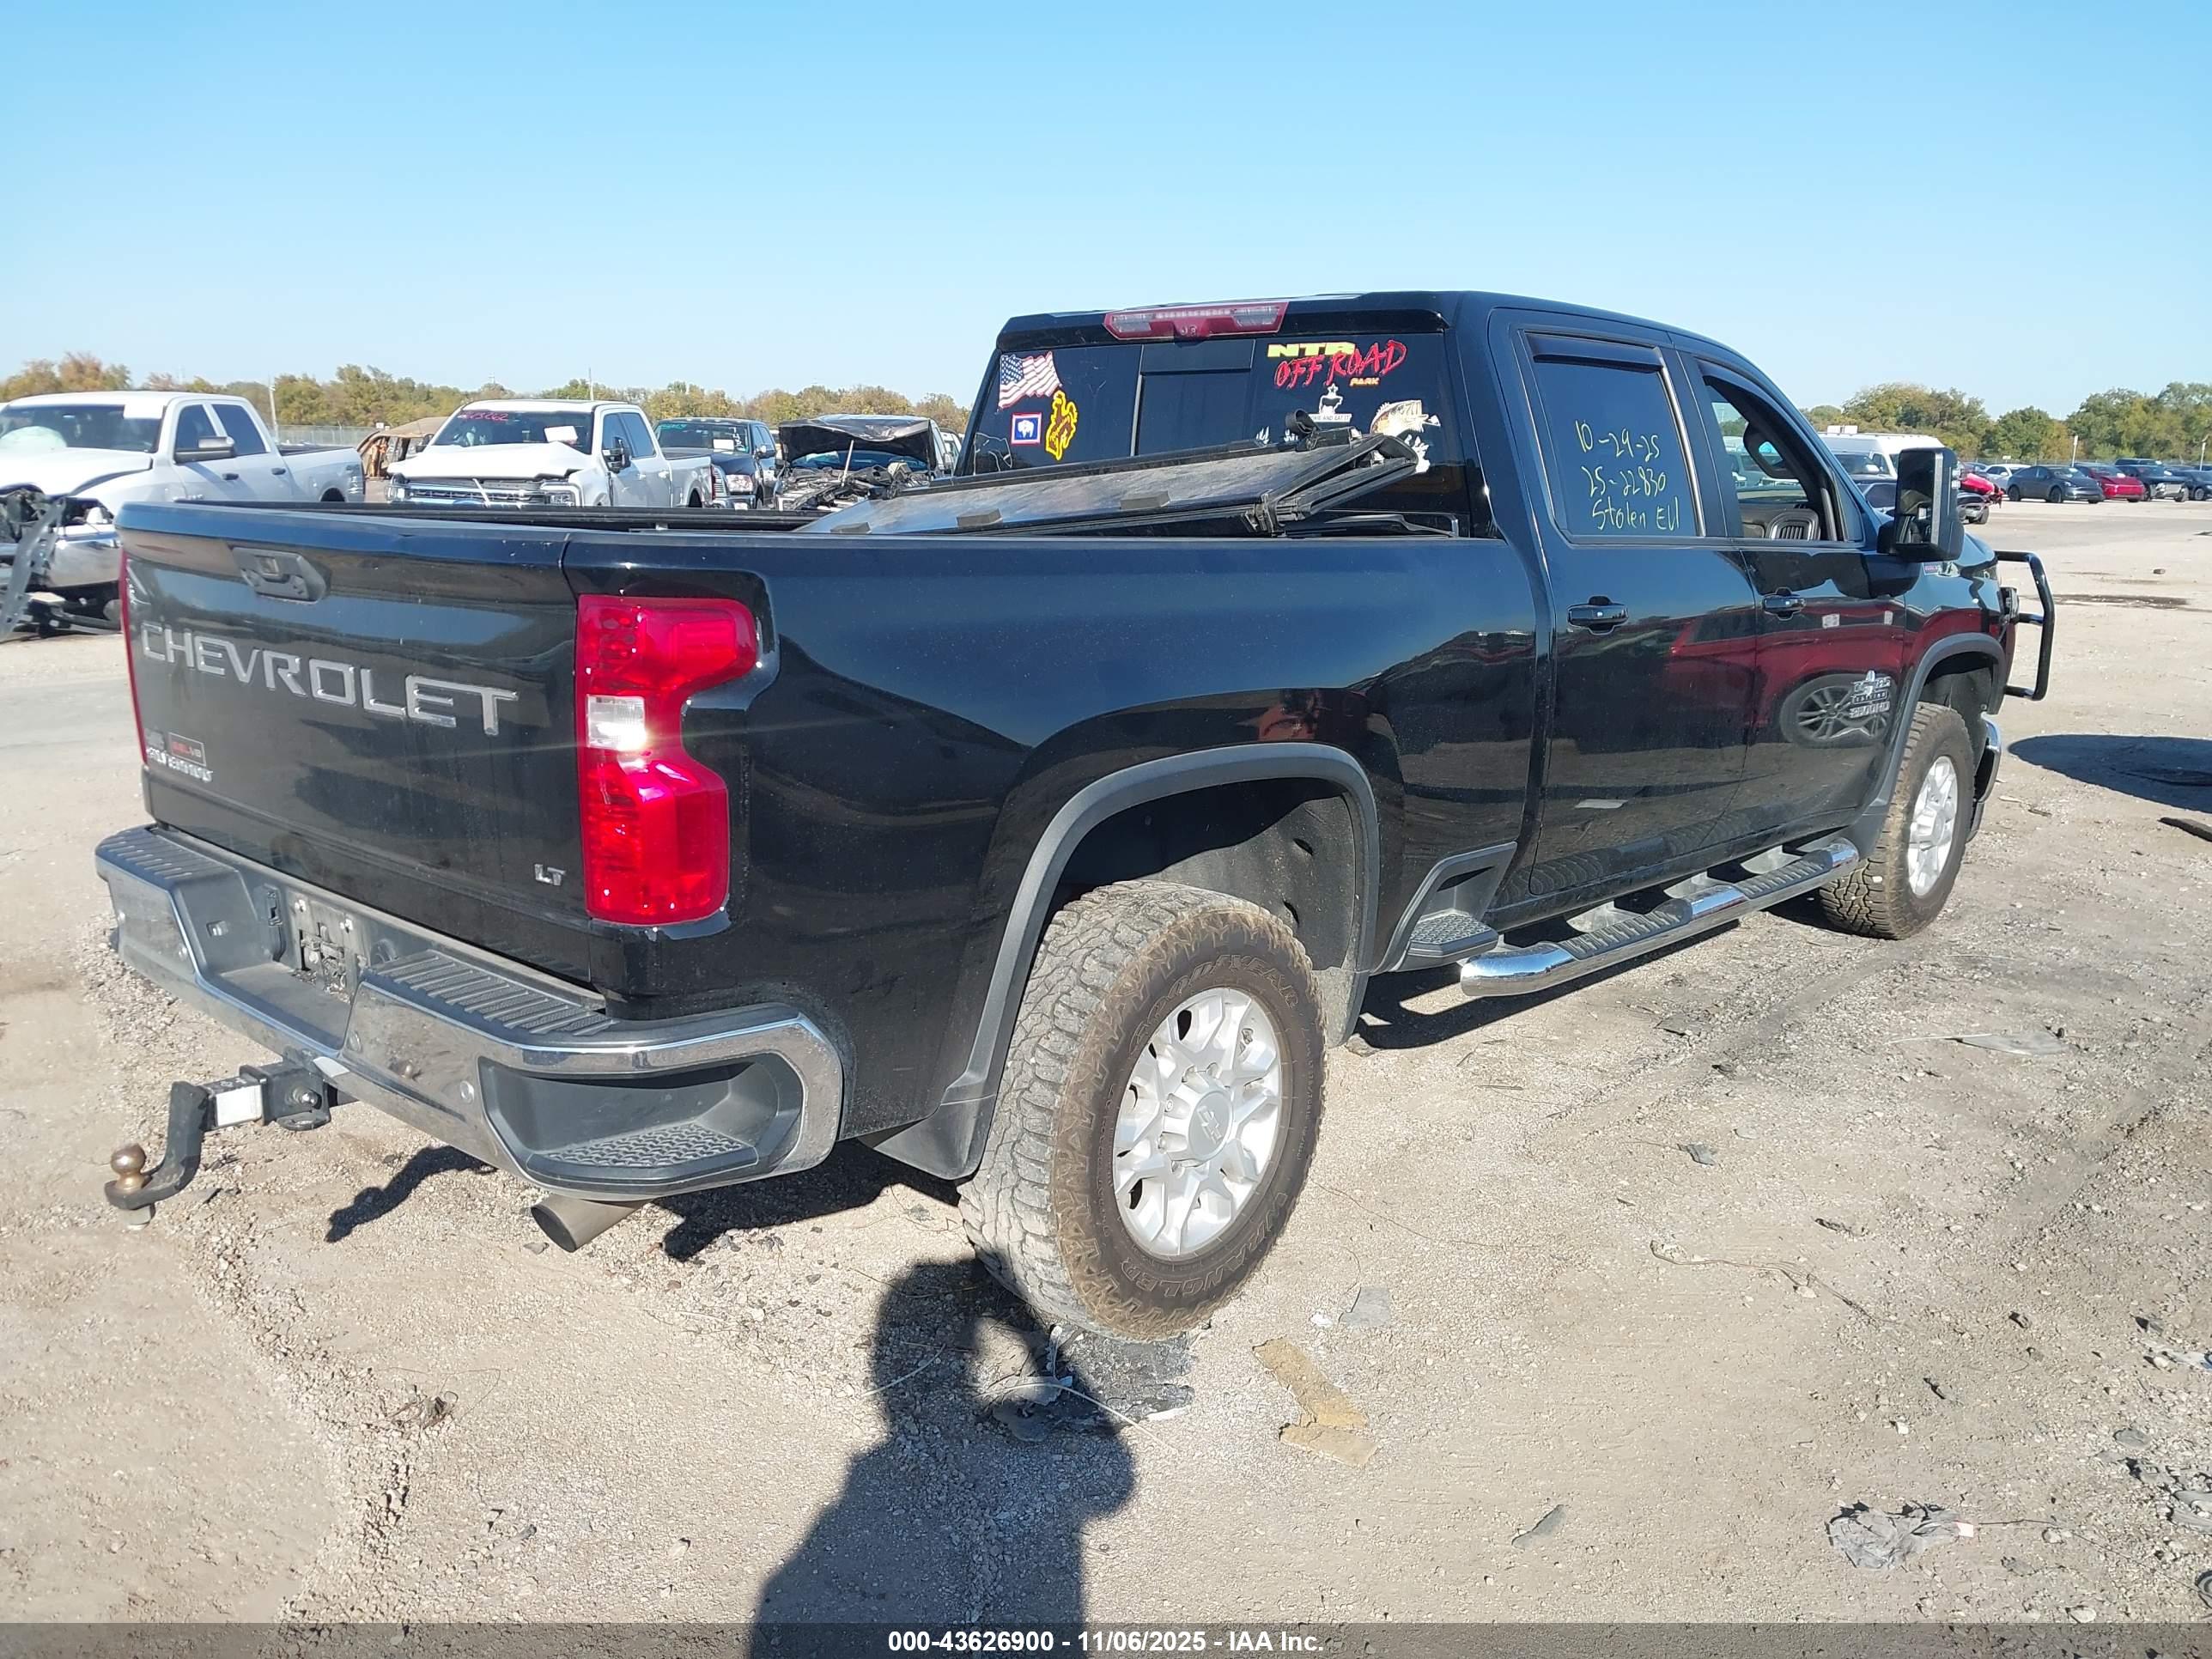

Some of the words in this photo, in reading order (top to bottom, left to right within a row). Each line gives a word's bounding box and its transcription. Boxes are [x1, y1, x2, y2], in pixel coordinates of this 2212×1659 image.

[1274, 354, 1325, 389] OFF
[1323, 339, 1407, 386] ROAD
[1349, 377, 1380, 387] PARK
[1592, 495, 1646, 531] Stolen
[139, 620, 520, 736] CHEVROLET
[534, 862, 566, 886] LT
[1128, 954, 1298, 1056] GOODYEAR
[1120, 1192, 1288, 1297] WRANGLER
